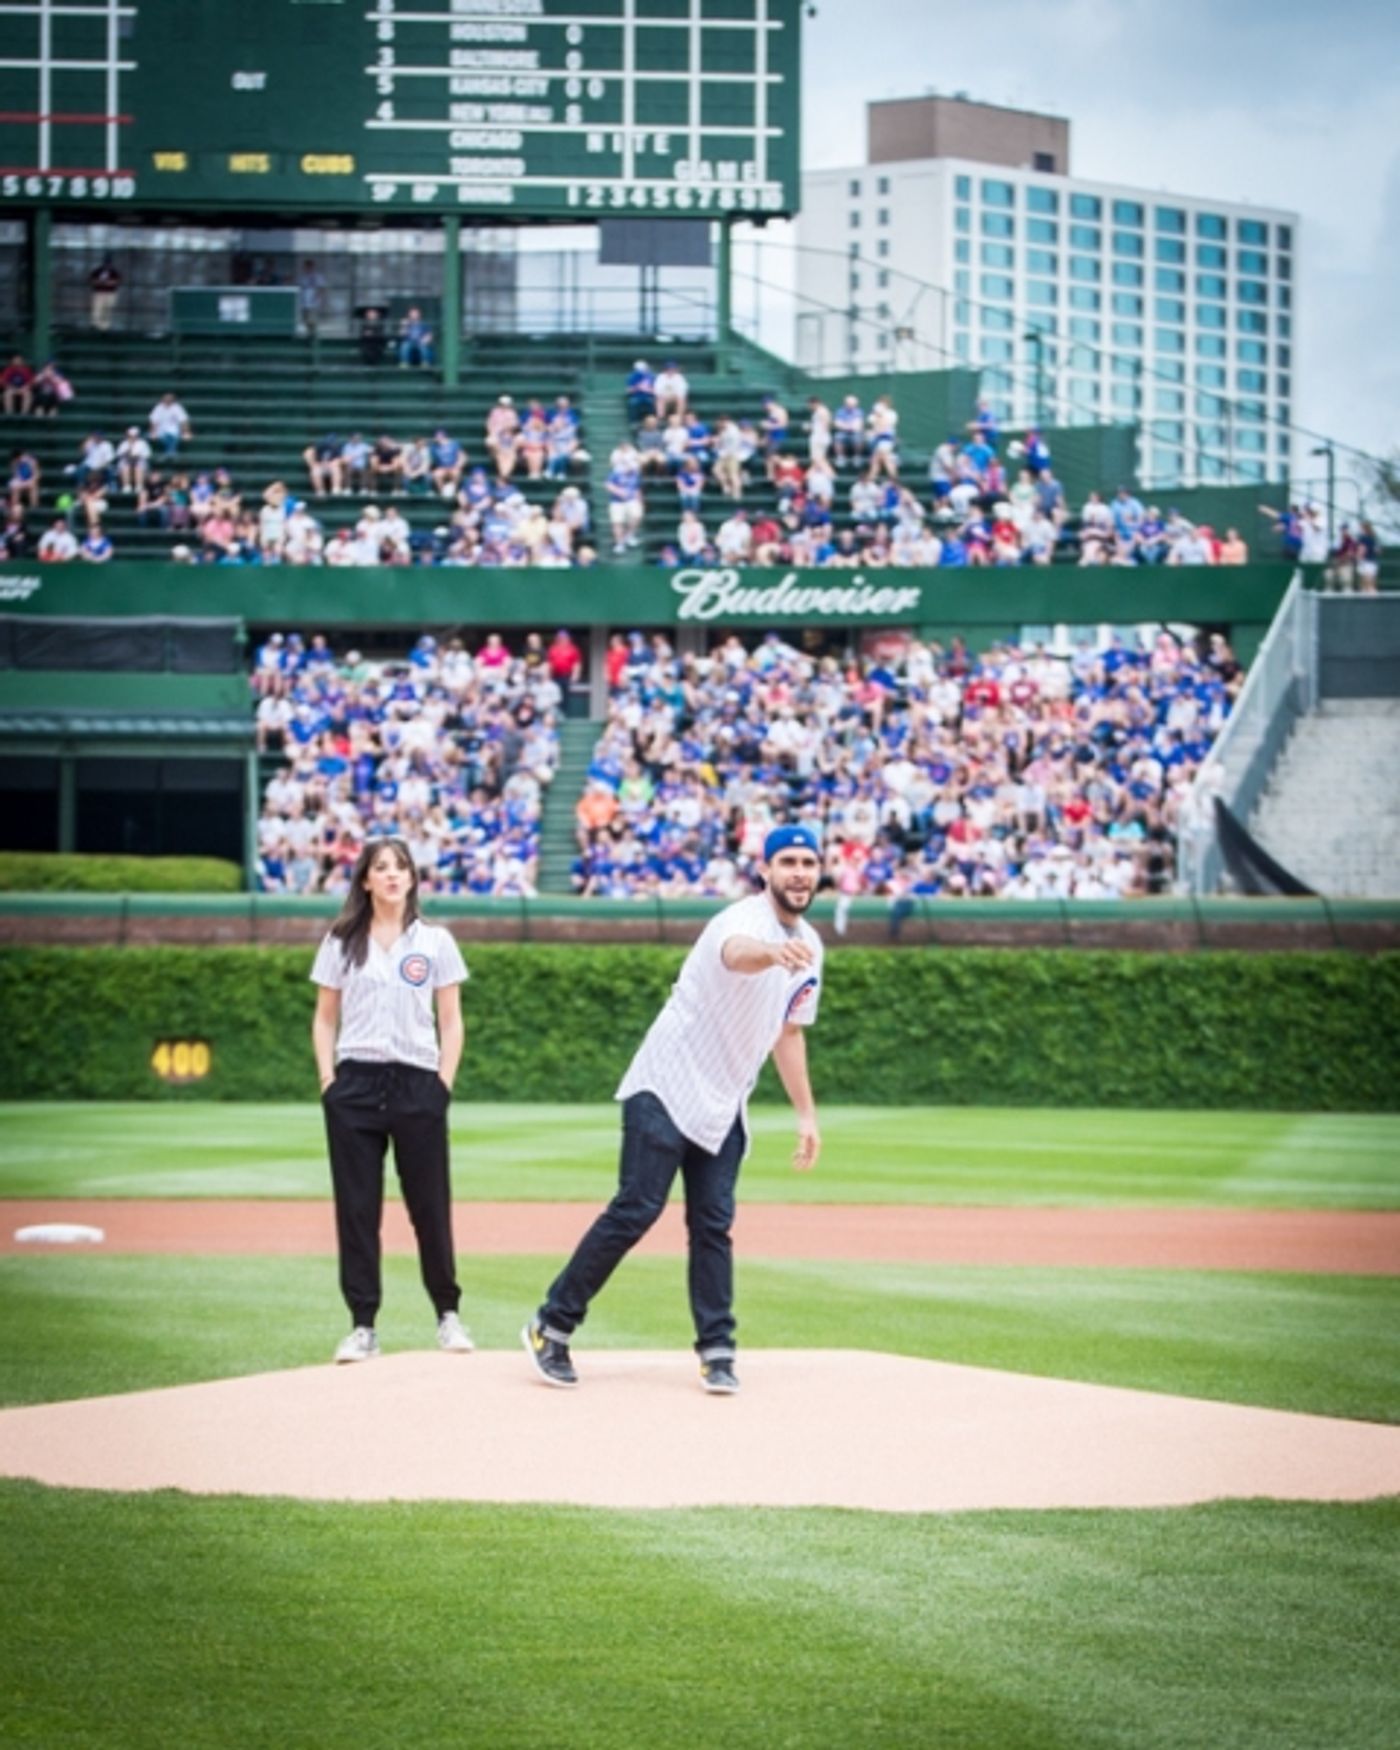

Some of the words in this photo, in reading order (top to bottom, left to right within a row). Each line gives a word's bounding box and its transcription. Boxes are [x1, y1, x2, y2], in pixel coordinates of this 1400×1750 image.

[378, 102, 394, 122] 4
[301, 154, 355, 174] CUBS
[2, 176, 19, 197] 5
[25, 177, 42, 197] 6
[48, 177, 65, 197] 7
[69, 177, 87, 198] 8
[93, 177, 110, 198] 9
[111, 177, 136, 199] 10
[566, 185, 579, 206] 1
[587, 186, 604, 206] 2
[610, 187, 626, 206] 3
[630, 187, 647, 206] 4
[653, 187, 669, 207] 5
[674, 187, 692, 208] 6
[697, 187, 713, 208] 7
[719, 188, 736, 209] 8
[741, 188, 757, 209] 9
[670, 569, 922, 620] Budweiser
[152, 1041, 210, 1078] 400
